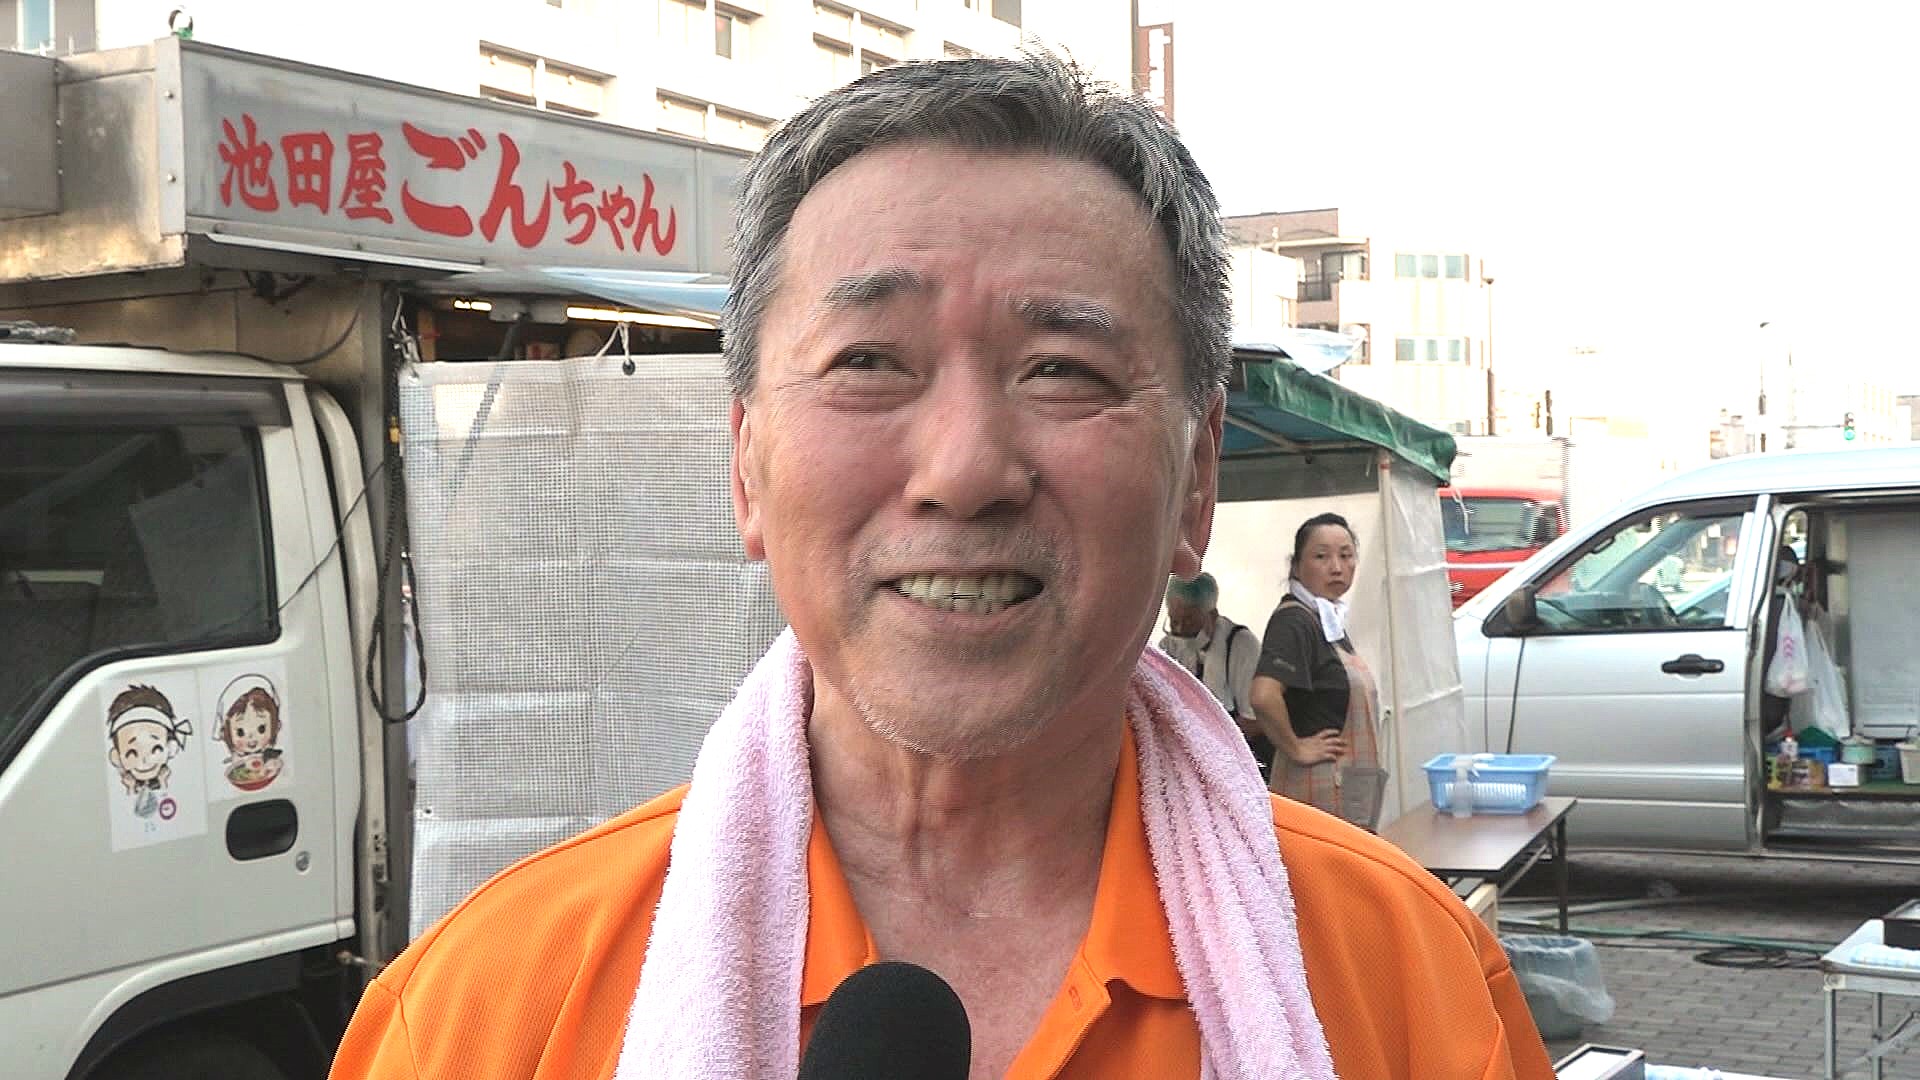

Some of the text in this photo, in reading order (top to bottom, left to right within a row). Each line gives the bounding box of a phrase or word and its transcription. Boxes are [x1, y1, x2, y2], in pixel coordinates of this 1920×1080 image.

[218, 114, 677, 257] 池田屋ごんちゃん
